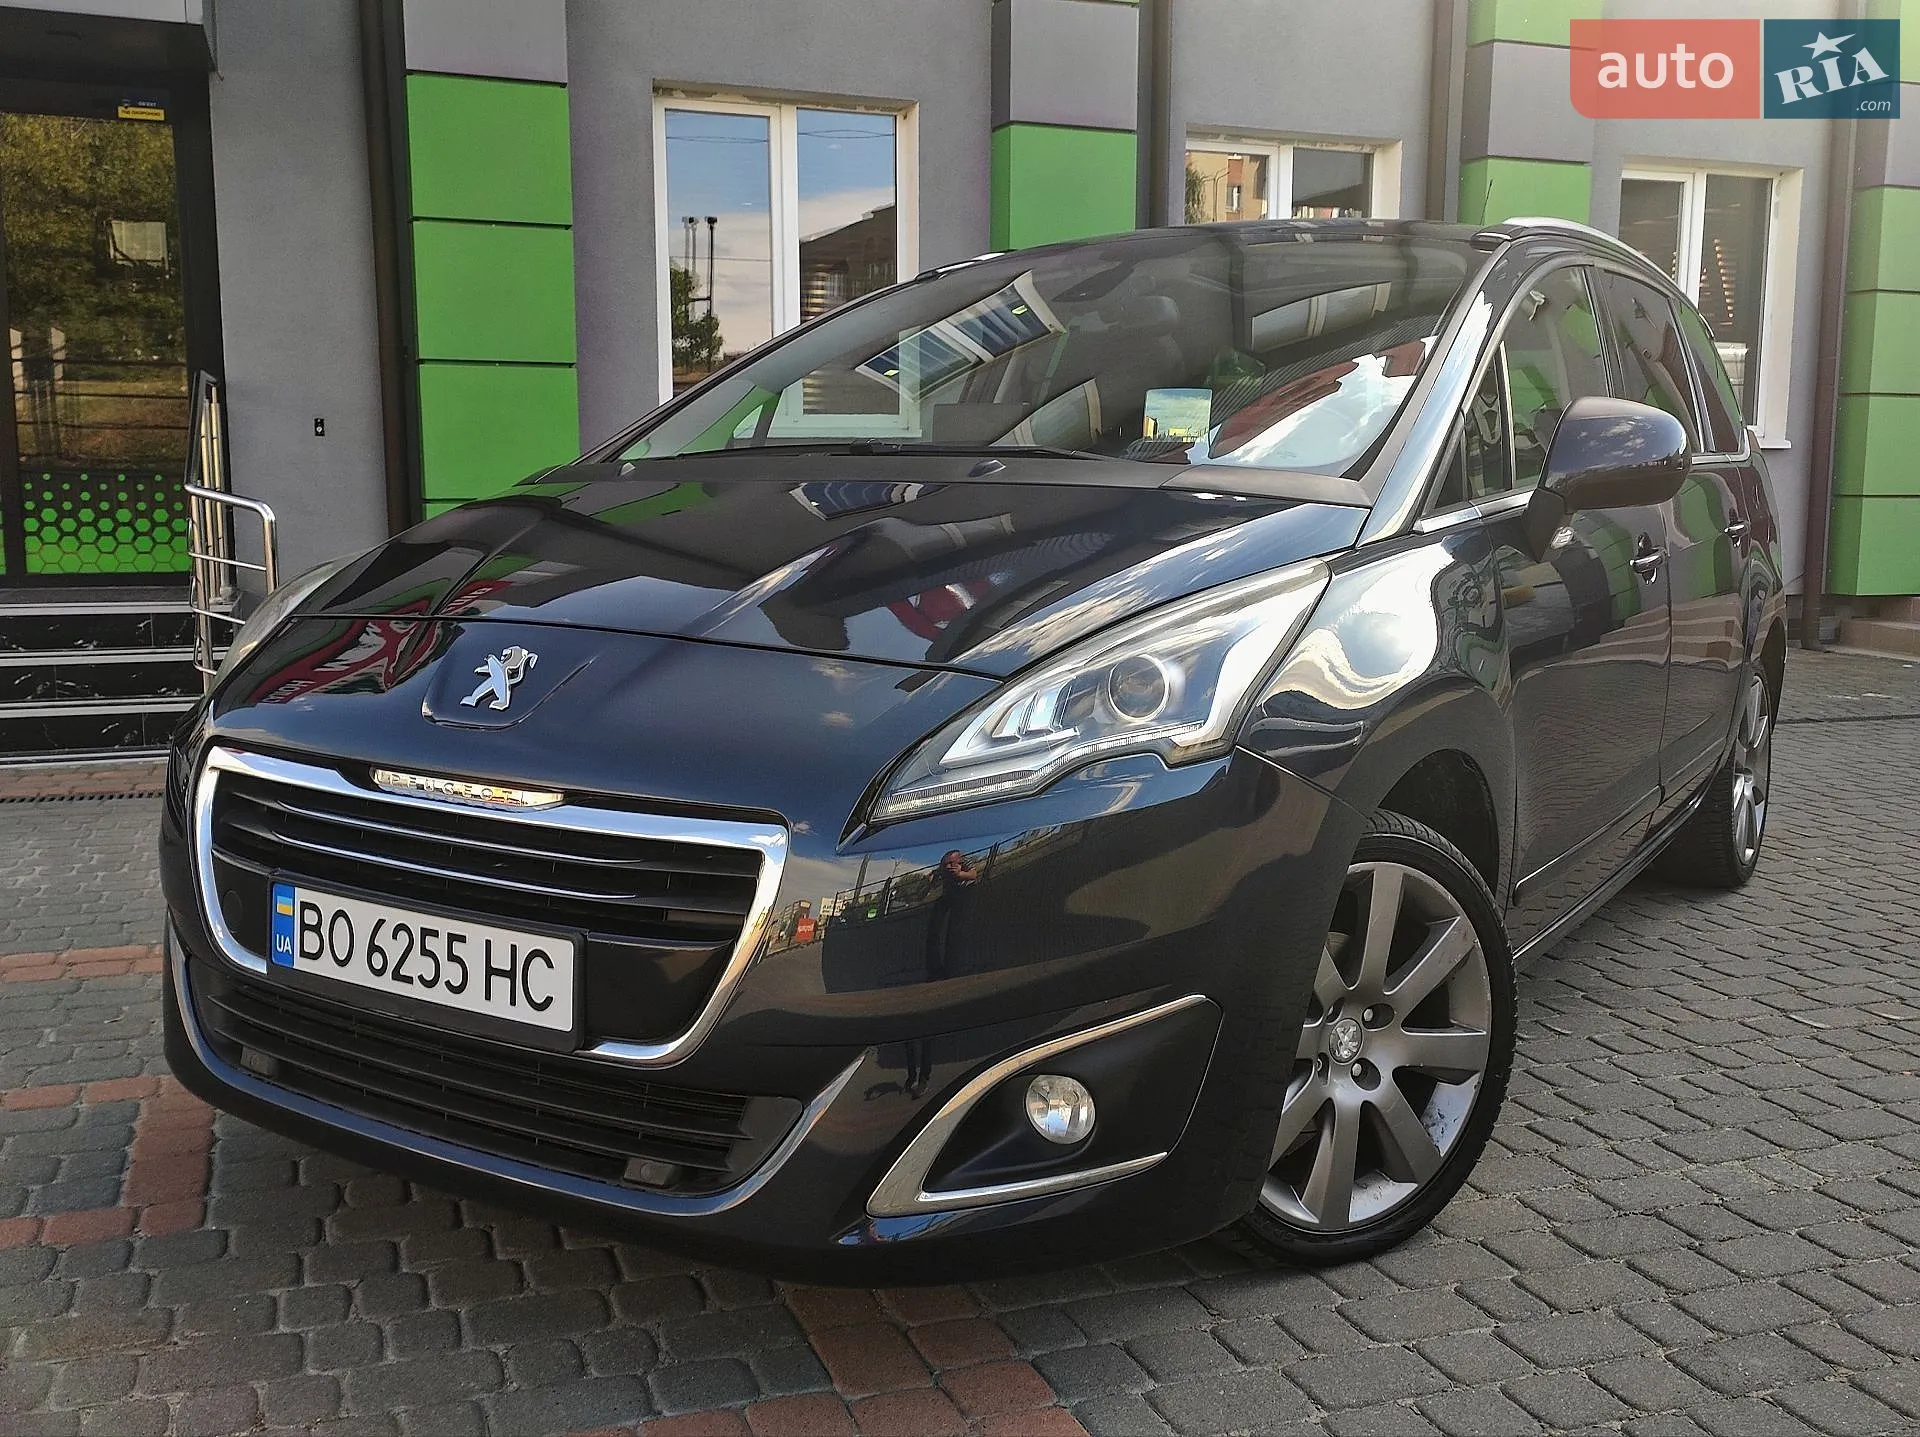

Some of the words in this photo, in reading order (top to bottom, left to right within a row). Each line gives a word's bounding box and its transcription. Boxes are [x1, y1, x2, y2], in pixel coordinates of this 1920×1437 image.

[389, 773, 514, 803] PEUGEOT
[275, 933, 293, 955] UA
[299, 900, 355, 968] BO
[366, 918, 469, 995] 6255
[484, 939, 555, 1012] HC
